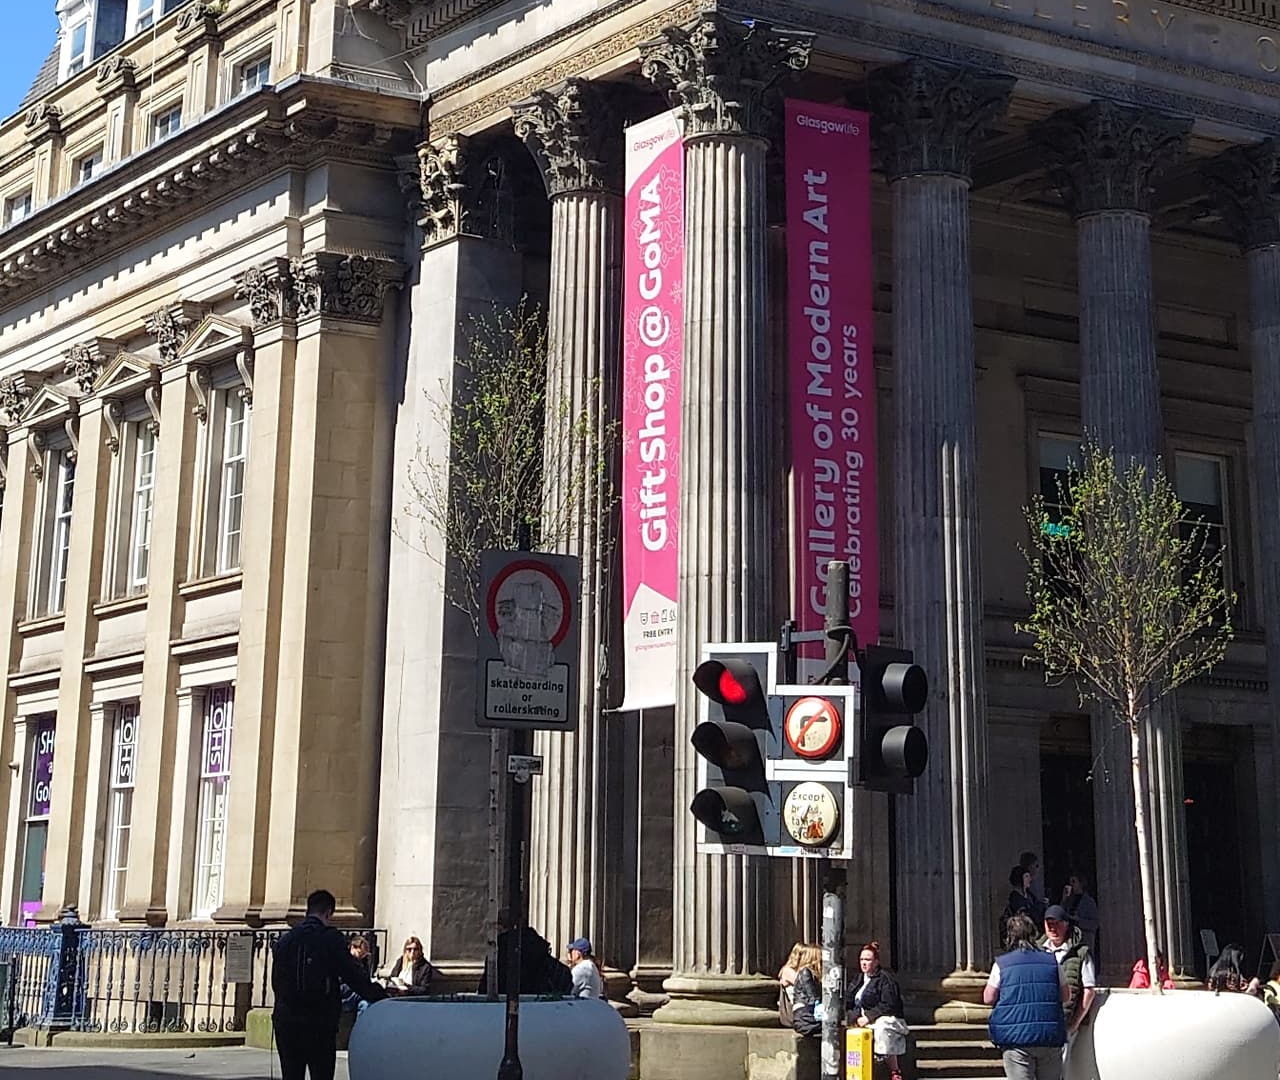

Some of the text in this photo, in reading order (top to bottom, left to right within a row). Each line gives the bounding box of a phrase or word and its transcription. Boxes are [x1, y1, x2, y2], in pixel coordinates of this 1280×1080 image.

[796, 115, 860, 136] Glasgowlife
[639, 171, 670, 552] Gift Shop @ GoMA
[803, 169, 841, 616] Gallery of Modern Art
[838, 324, 864, 618] Celebrating 30 years
[490, 678, 564, 693] skateboarding
[521, 694, 533, 702] or
[494, 704, 559, 718] rollerskating
[792, 792, 825, 802] Except
